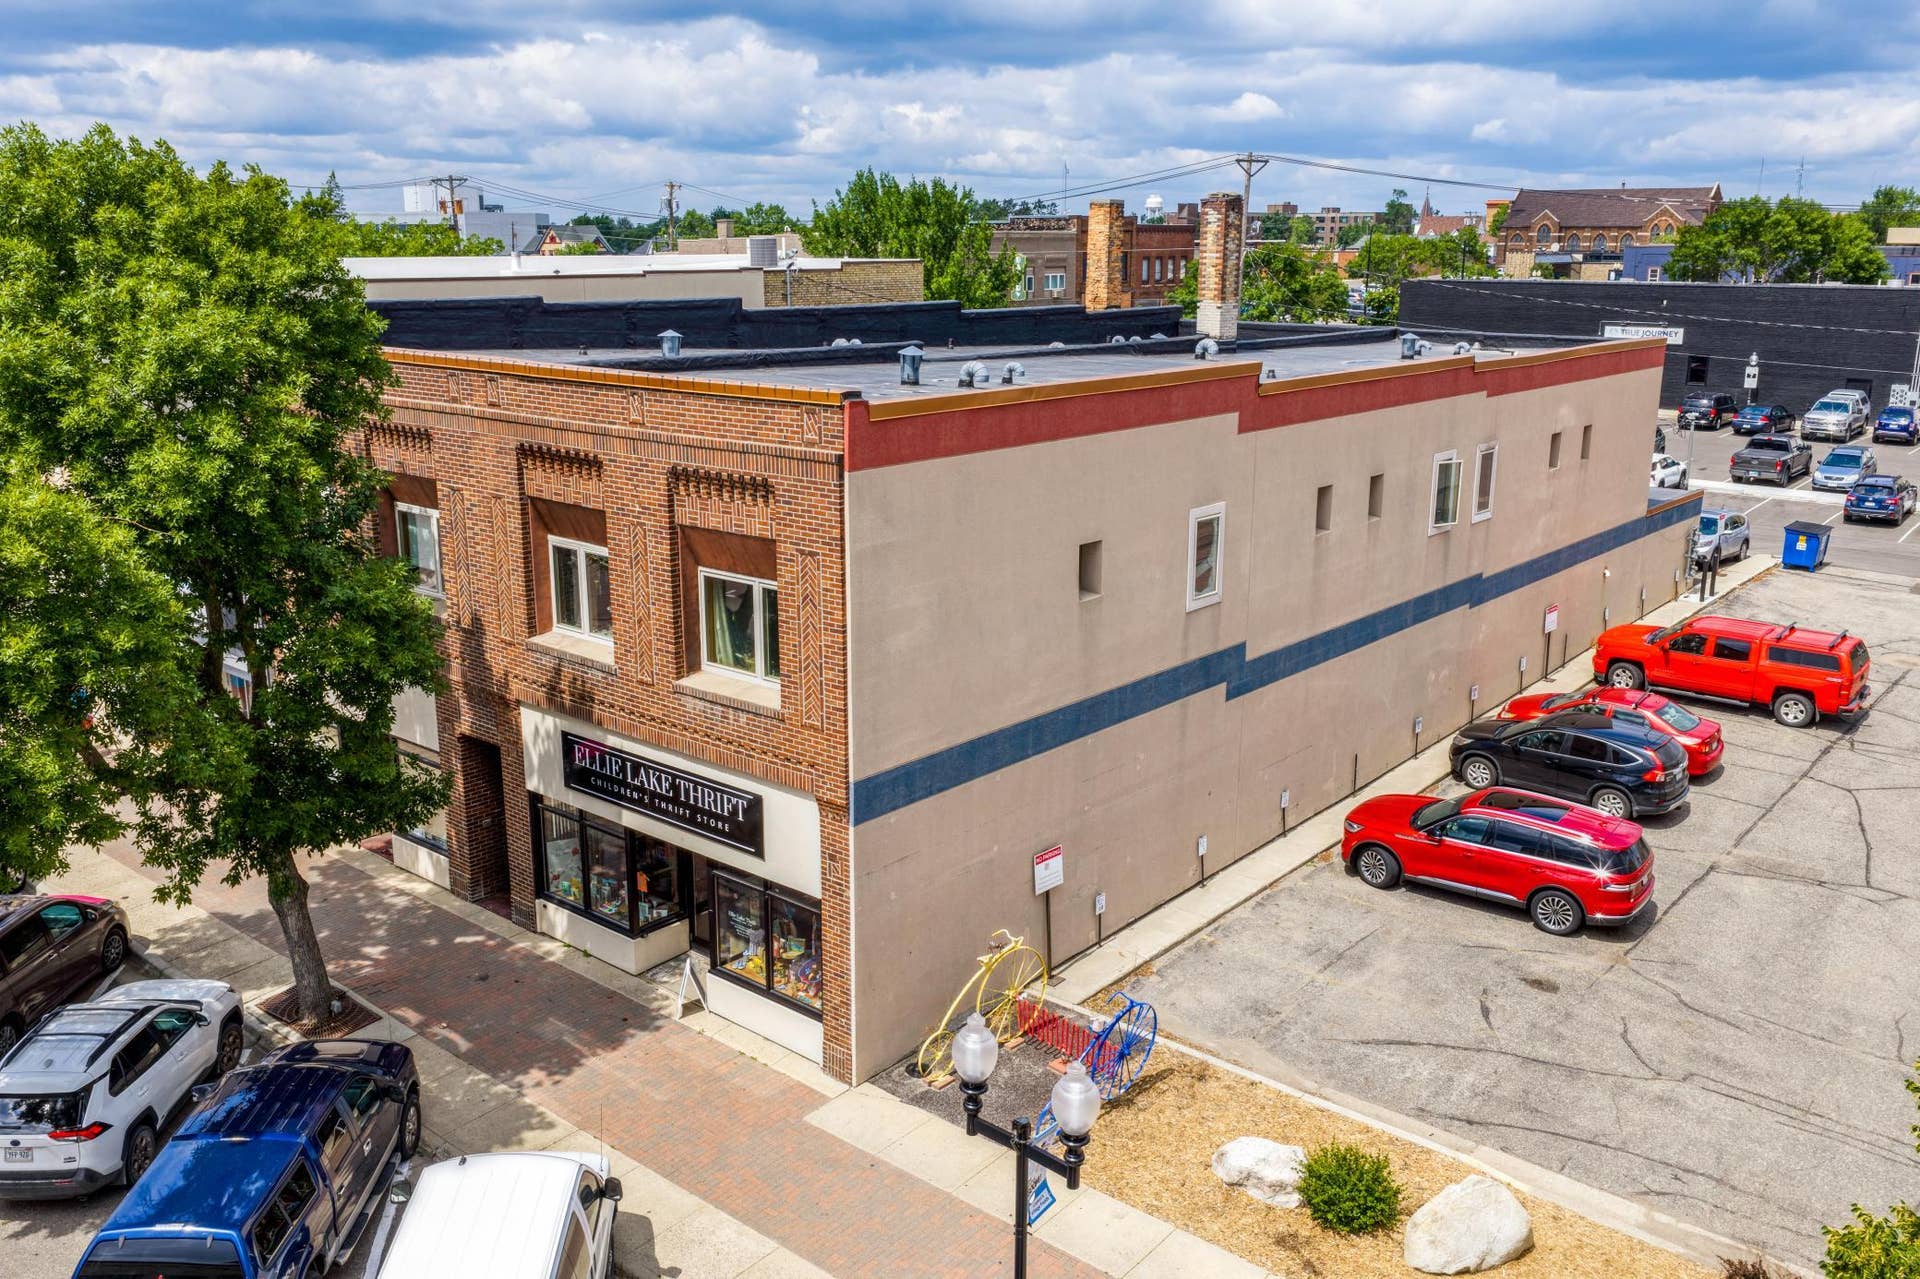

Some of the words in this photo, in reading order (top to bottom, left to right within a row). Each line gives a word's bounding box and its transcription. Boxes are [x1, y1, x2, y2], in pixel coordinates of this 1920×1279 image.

[1641, 329, 1679, 337] JOURNEY
[574, 744, 623, 779] ELLIE
[625, 761, 673, 797] LAKE
[676, 778, 748, 822] THRIFT
[590, 777, 649, 803] CHILDREN'S
[655, 799, 690, 819] THRIFT
[697, 814, 730, 832] STORE
